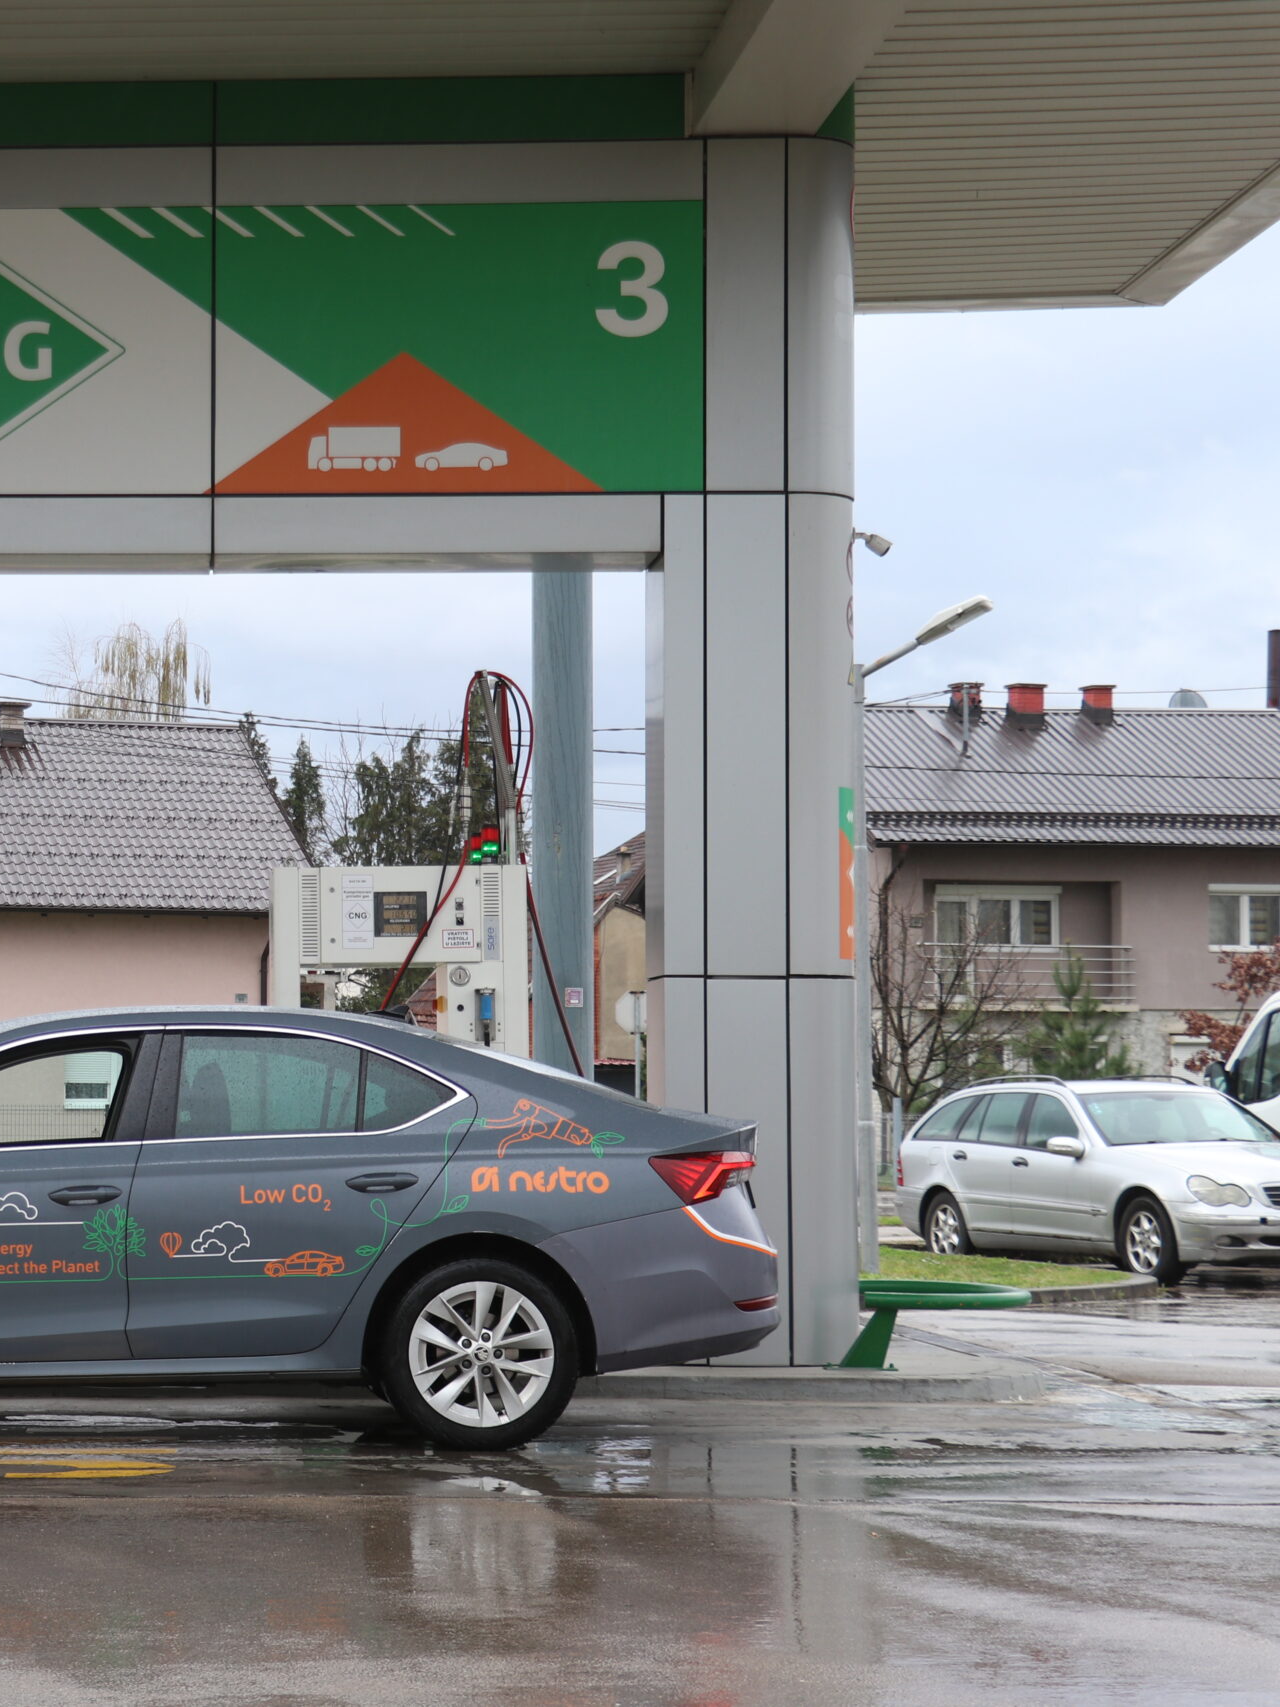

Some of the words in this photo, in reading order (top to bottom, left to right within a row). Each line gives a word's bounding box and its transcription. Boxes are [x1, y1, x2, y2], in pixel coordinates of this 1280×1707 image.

[595, 240, 669, 338] 3
[348, 911, 368, 921] CNG
[239, 1184, 287, 1205] Low
[23, 1260, 49, 1275] the
[51, 1259, 101, 1274] Planet
